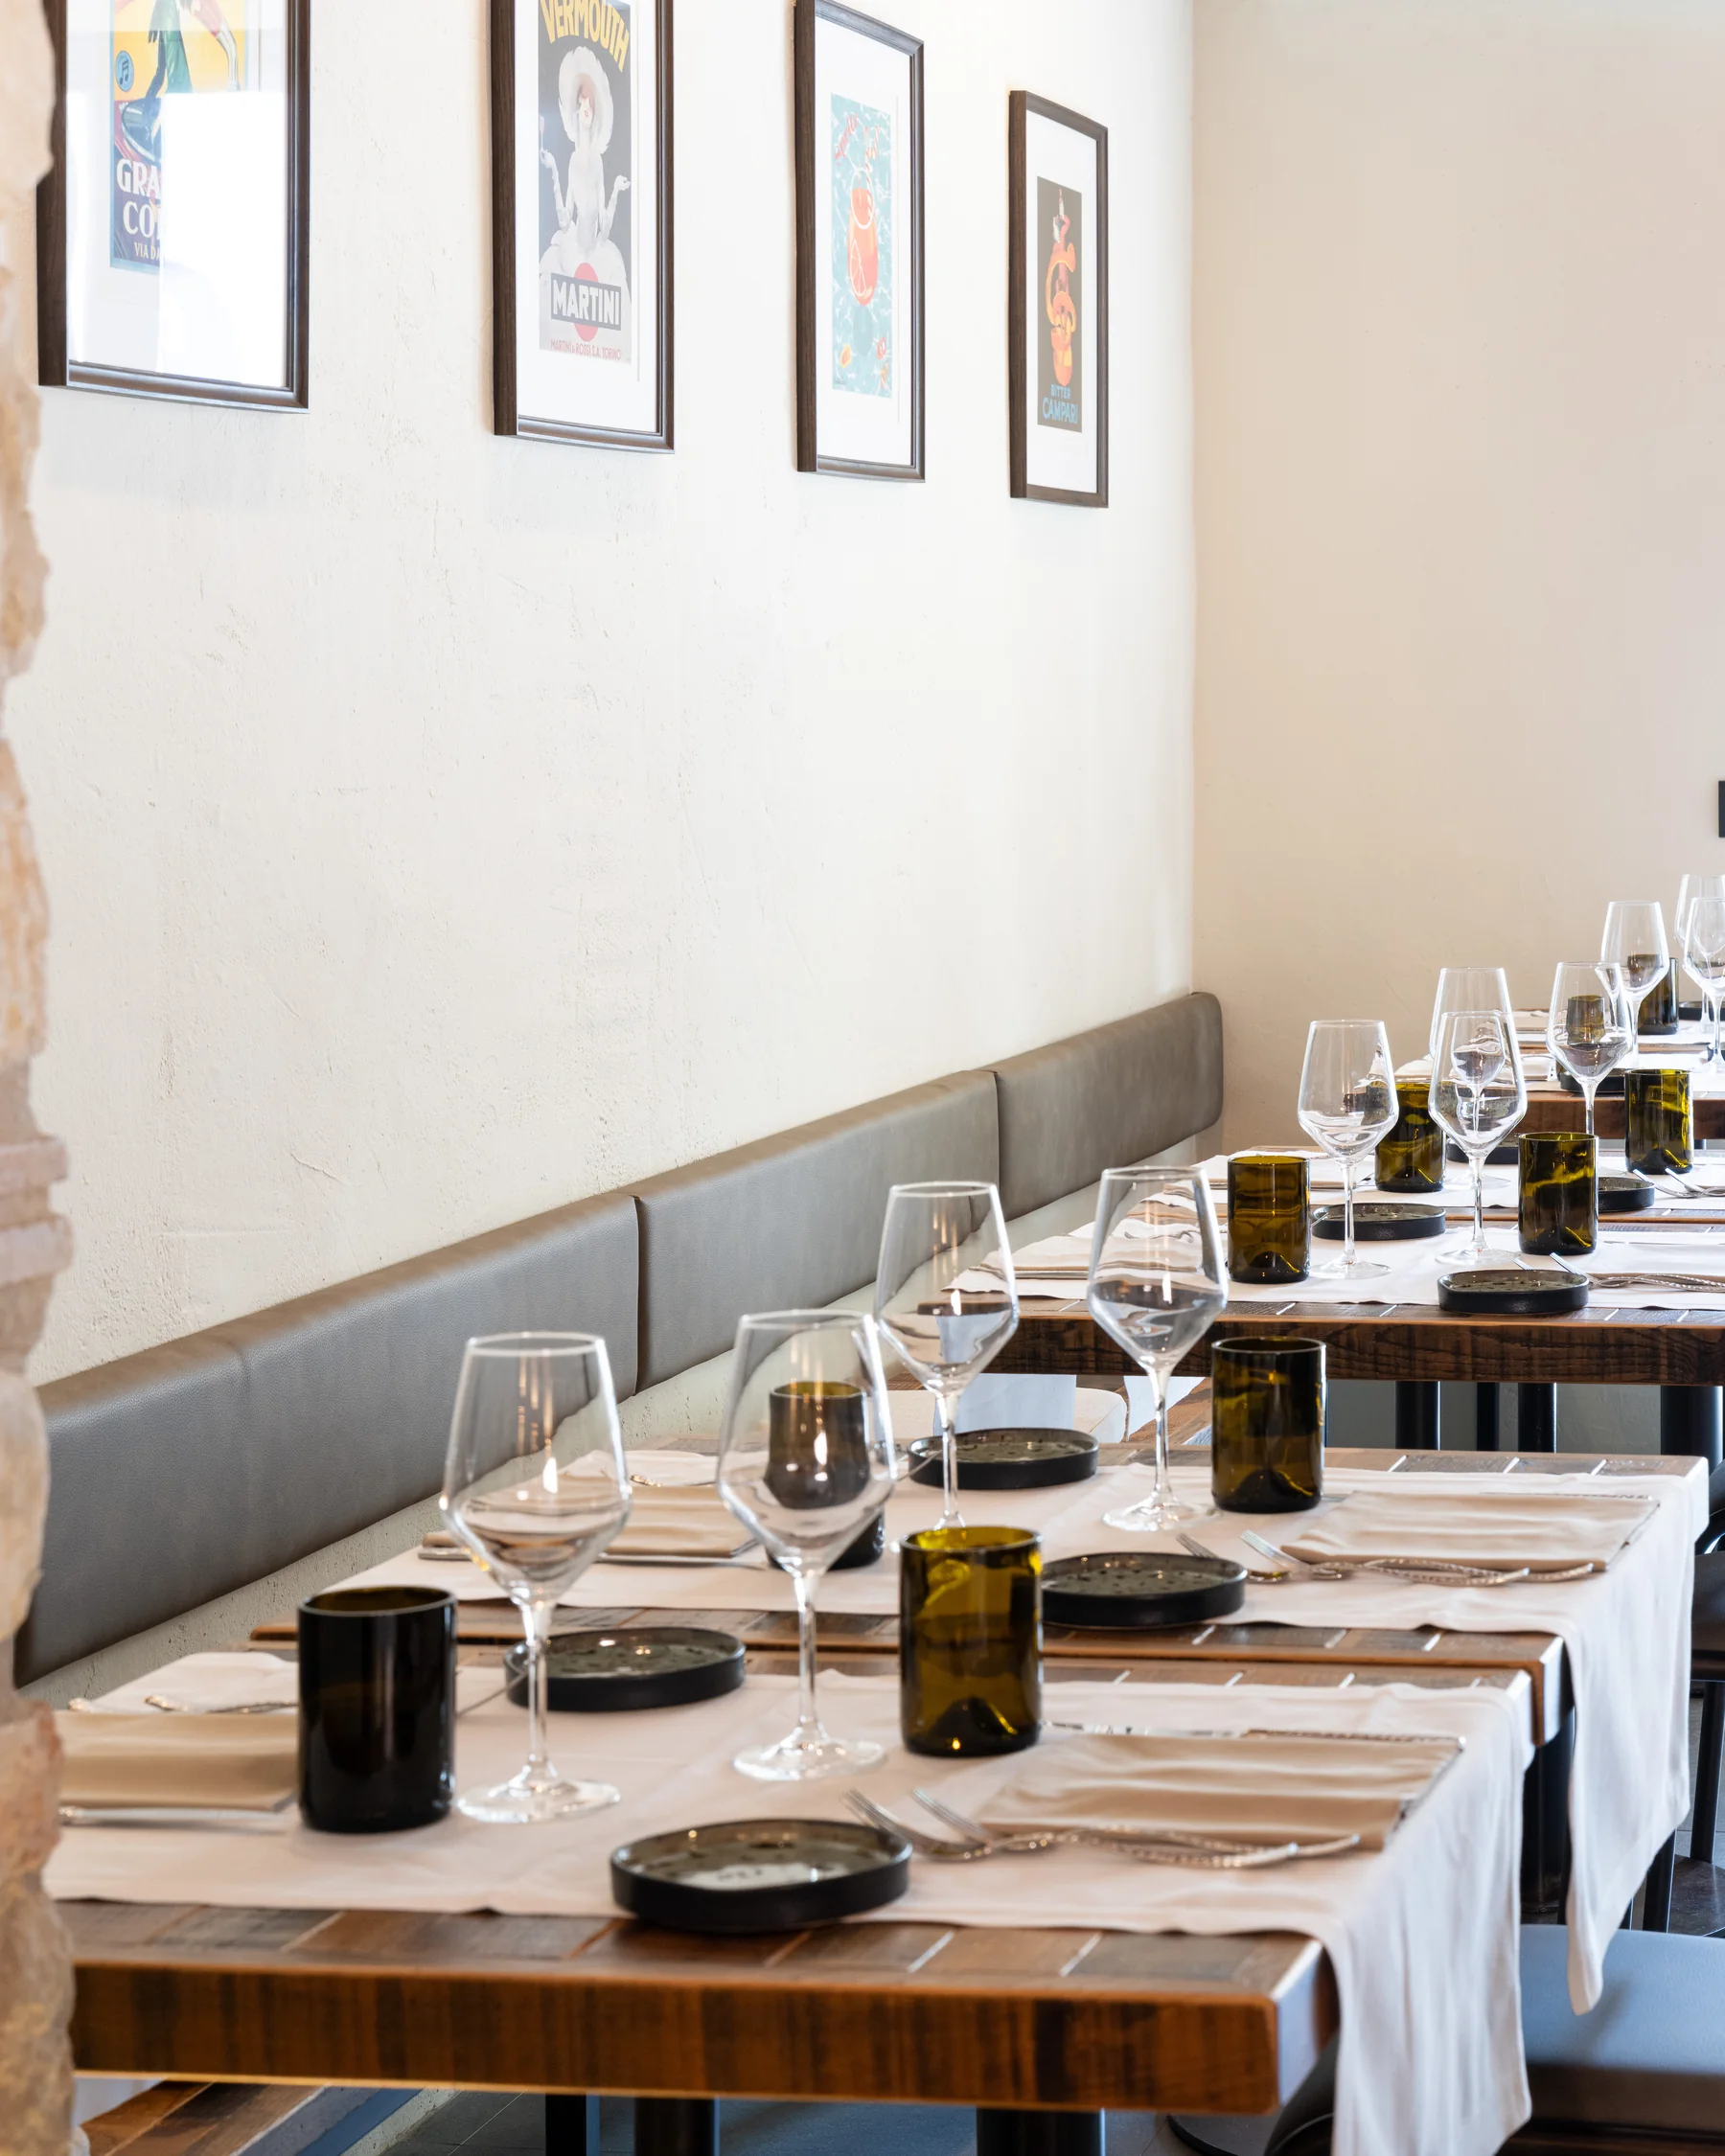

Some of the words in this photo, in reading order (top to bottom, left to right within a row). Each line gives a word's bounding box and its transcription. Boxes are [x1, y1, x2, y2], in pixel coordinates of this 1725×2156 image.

[540, 0, 630, 73] VERMOUTH
[134, 241, 149, 259] VIA
[553, 279, 620, 326] MARTINI
[550, 338, 572, 354] MARTINI
[1050, 384, 1070, 400] BITTER
[1042, 397, 1078, 424] CAMPARI
